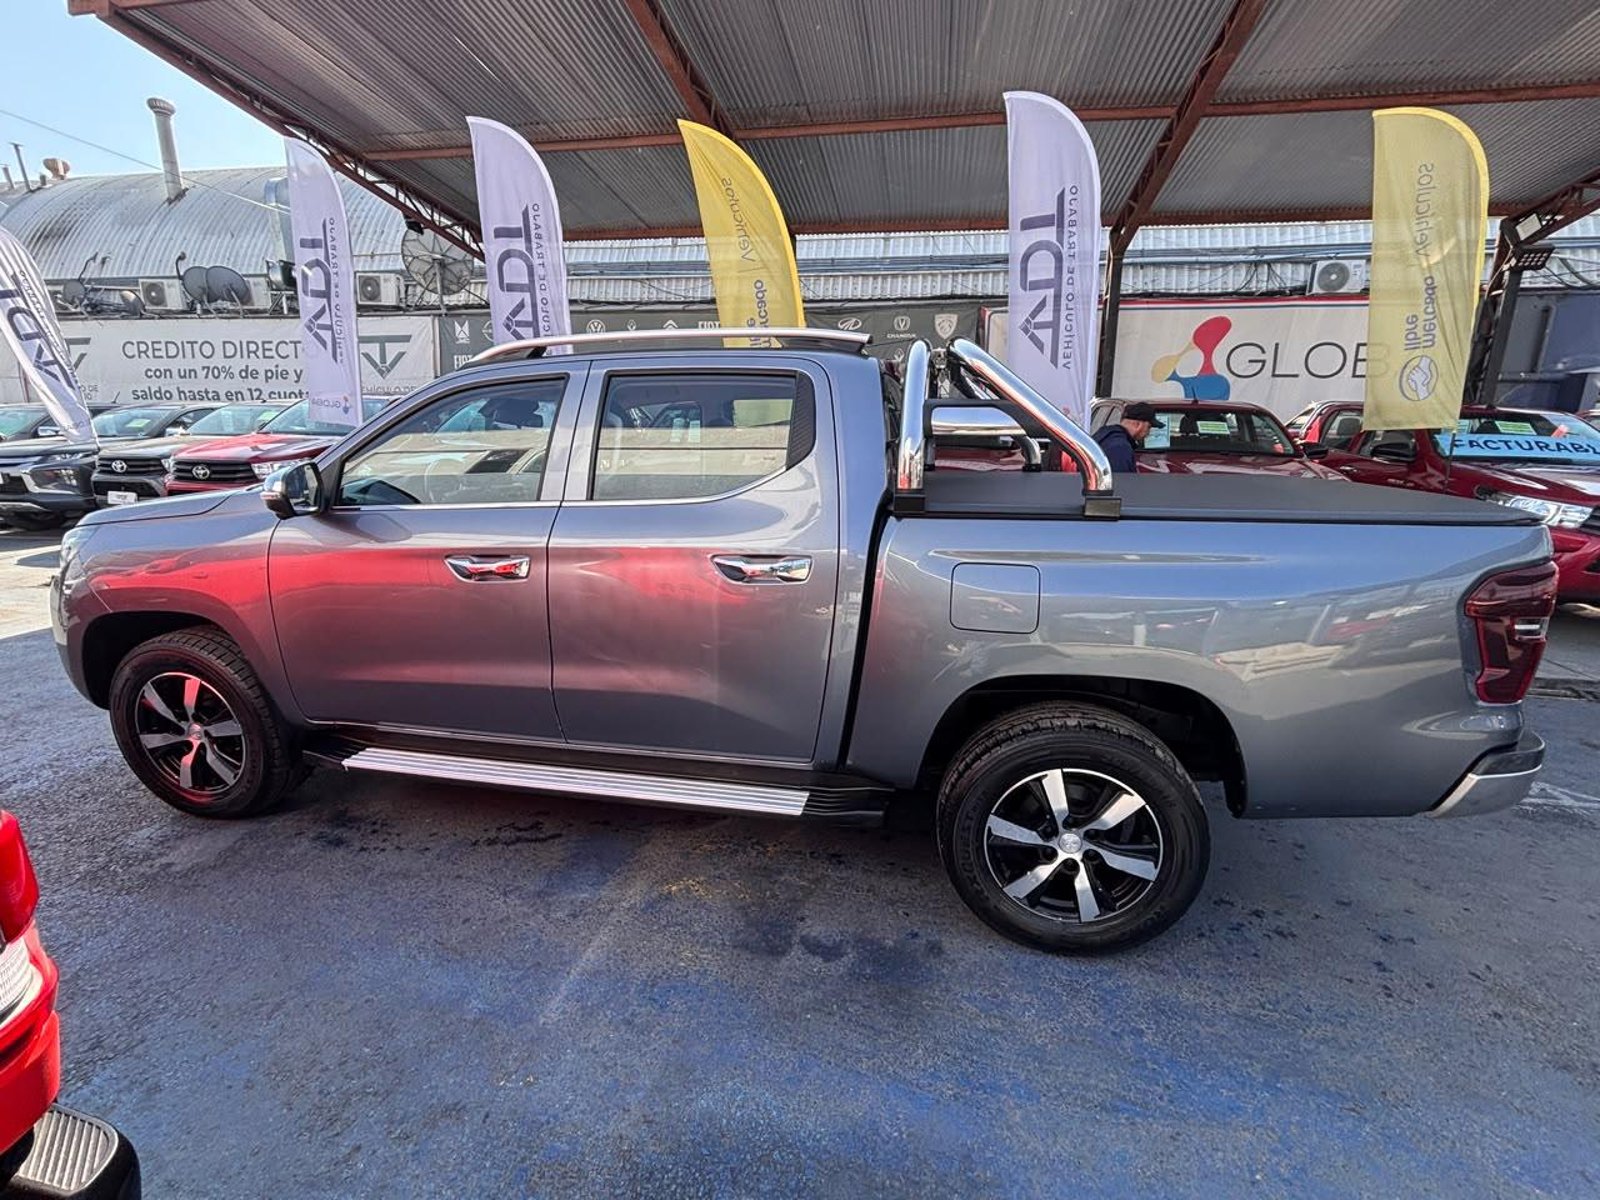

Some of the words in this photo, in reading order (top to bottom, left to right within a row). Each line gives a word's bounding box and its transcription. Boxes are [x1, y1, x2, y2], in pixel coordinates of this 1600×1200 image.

[121, 340, 216, 360] CREDITO
[222, 340, 304, 360] DIRECT
[144, 367, 173, 380] con
[178, 367, 198, 380] un
[202, 366, 235, 380] 70%
[239, 365, 259, 380] de
[261, 365, 290, 384] pie
[292, 368, 304, 383] y
[131, 387, 173, 401] saldo
[177, 387, 221, 402] hasta
[225, 390, 245, 402] en
[248, 388, 263, 400] 12
